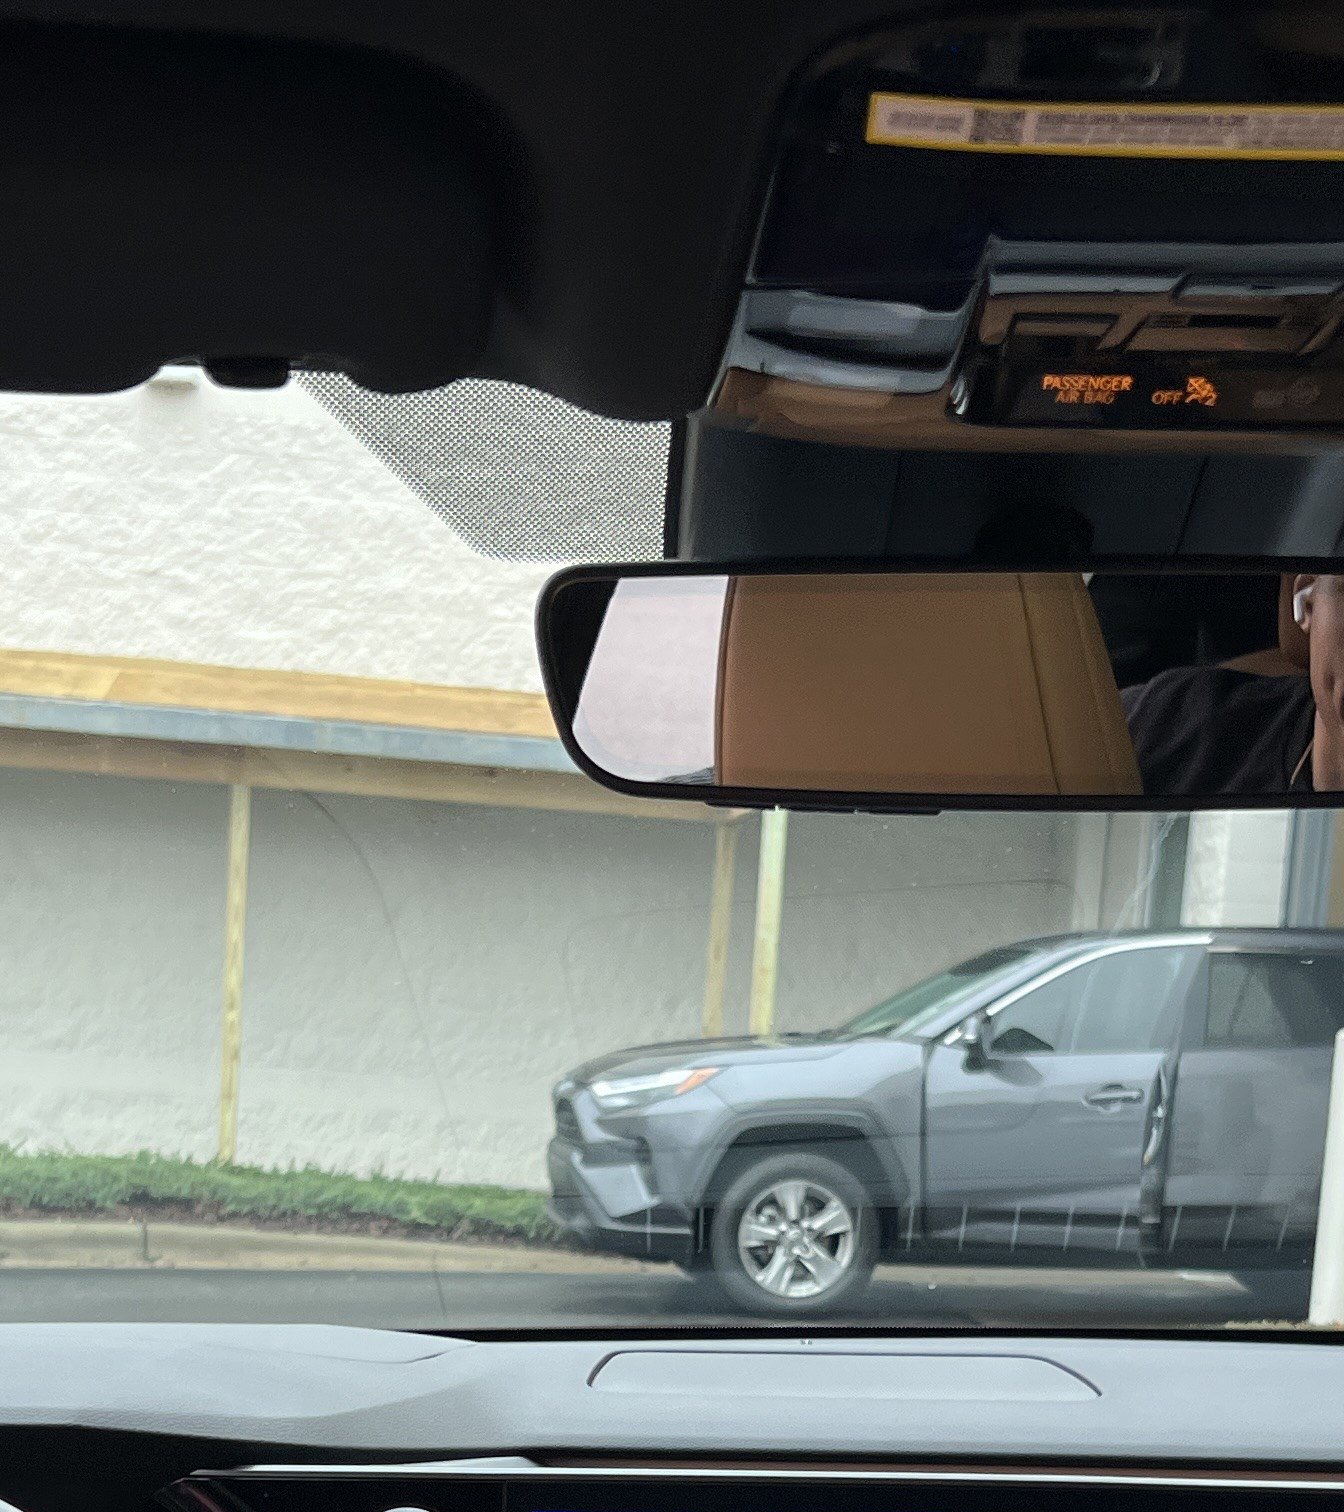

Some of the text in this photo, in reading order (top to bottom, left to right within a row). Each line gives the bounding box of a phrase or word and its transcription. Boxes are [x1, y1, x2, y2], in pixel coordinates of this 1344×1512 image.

[1042, 374, 1133, 391] PASSENGER
[1056, 391, 1079, 404] AIR
[1151, 391, 1183, 406] OFF
